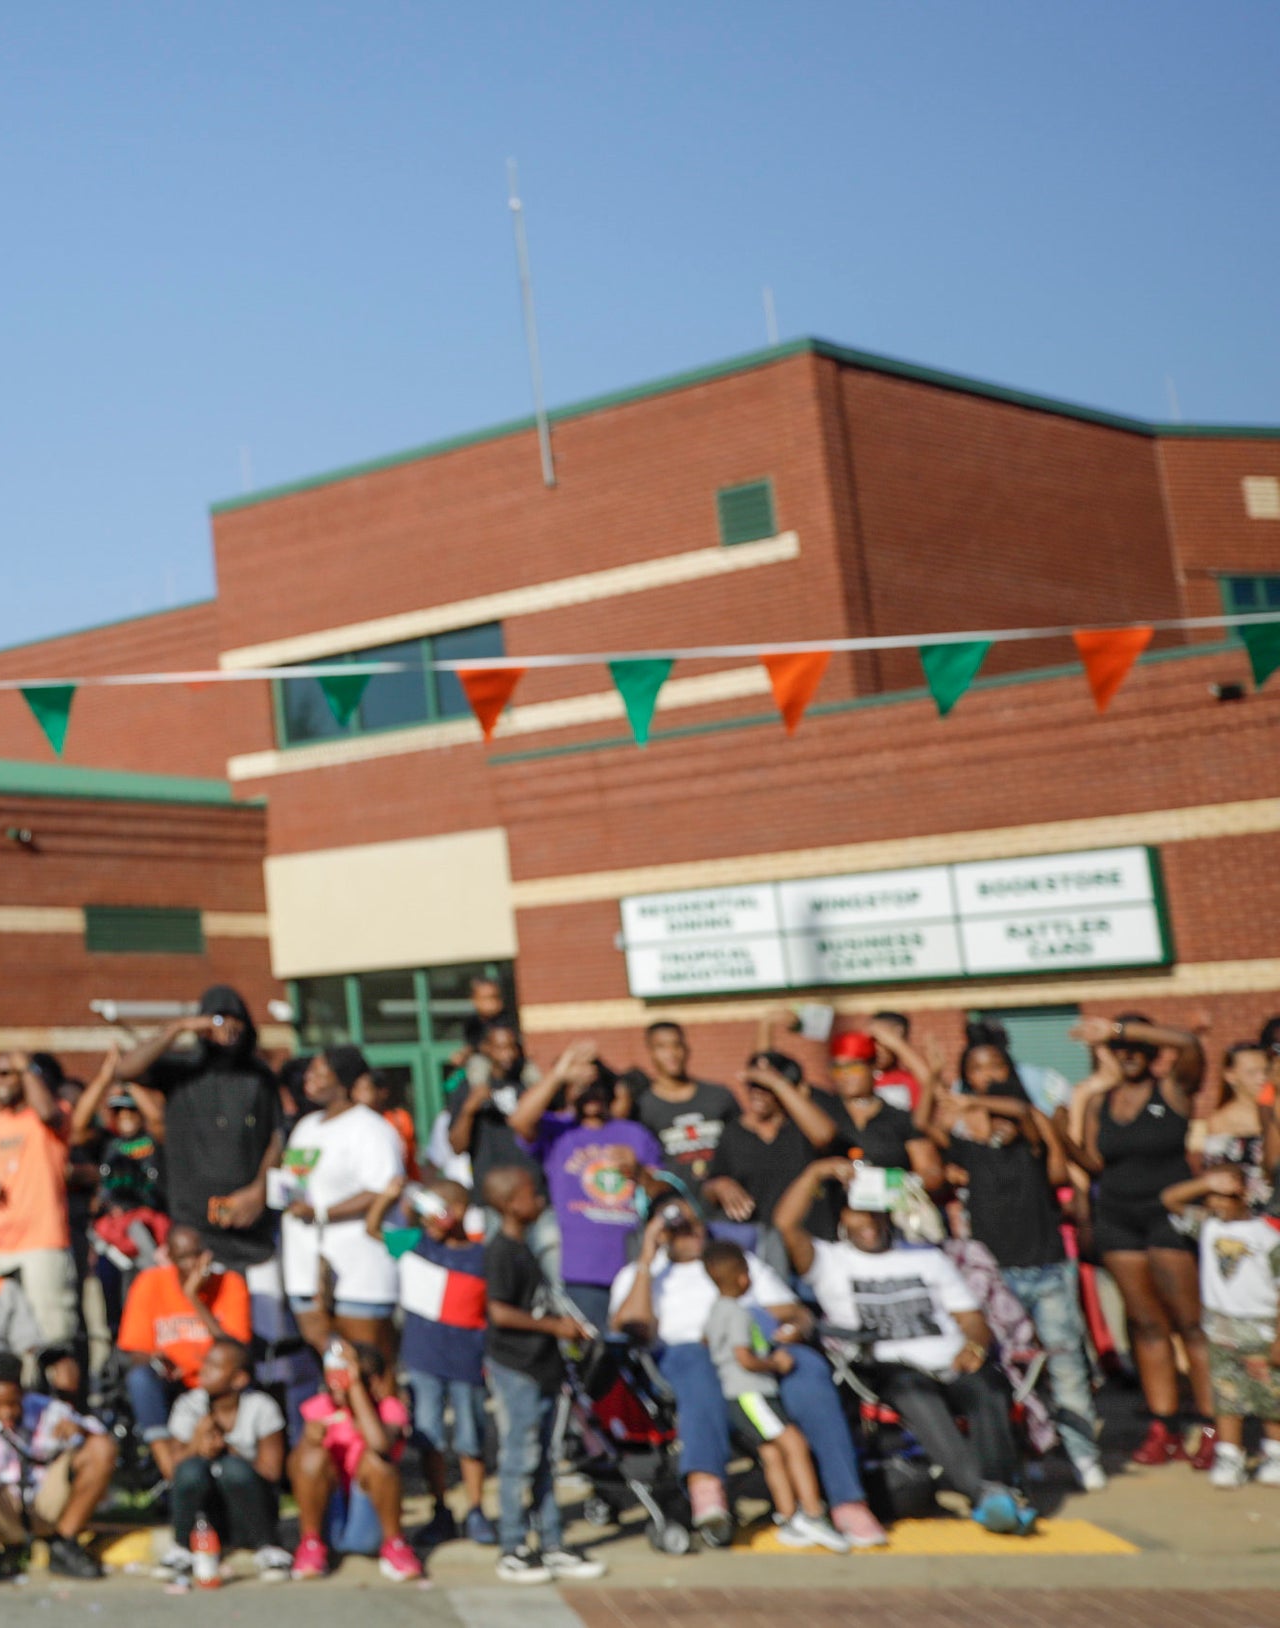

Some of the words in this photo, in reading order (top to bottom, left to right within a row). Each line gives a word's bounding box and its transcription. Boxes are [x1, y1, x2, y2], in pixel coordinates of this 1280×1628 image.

[978, 870, 1122, 898] BOOKSTORE
[1006, 917, 1111, 938] RATTLER
[817, 932, 923, 953] BUSINESS
[1028, 940, 1094, 959] CARD
